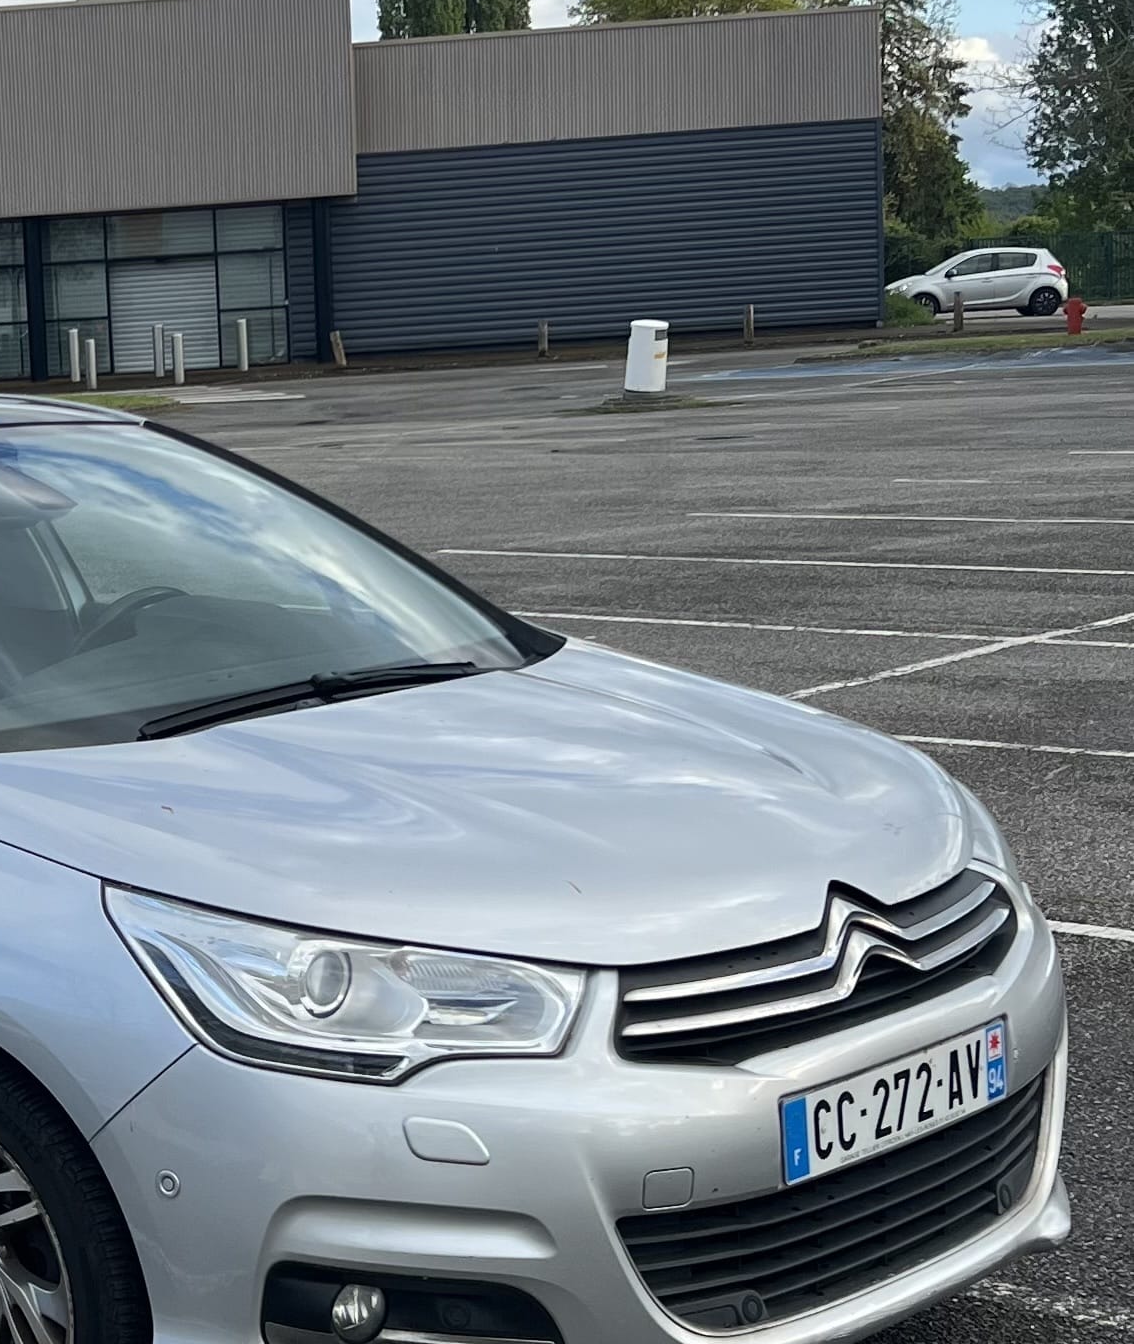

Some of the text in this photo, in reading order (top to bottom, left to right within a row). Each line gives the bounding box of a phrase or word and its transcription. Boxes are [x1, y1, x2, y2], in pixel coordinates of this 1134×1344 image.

[988, 1064, 1004, 1094] 94
[813, 1040, 981, 1160] CC-272-AV
[793, 1148, 803, 1167] F
